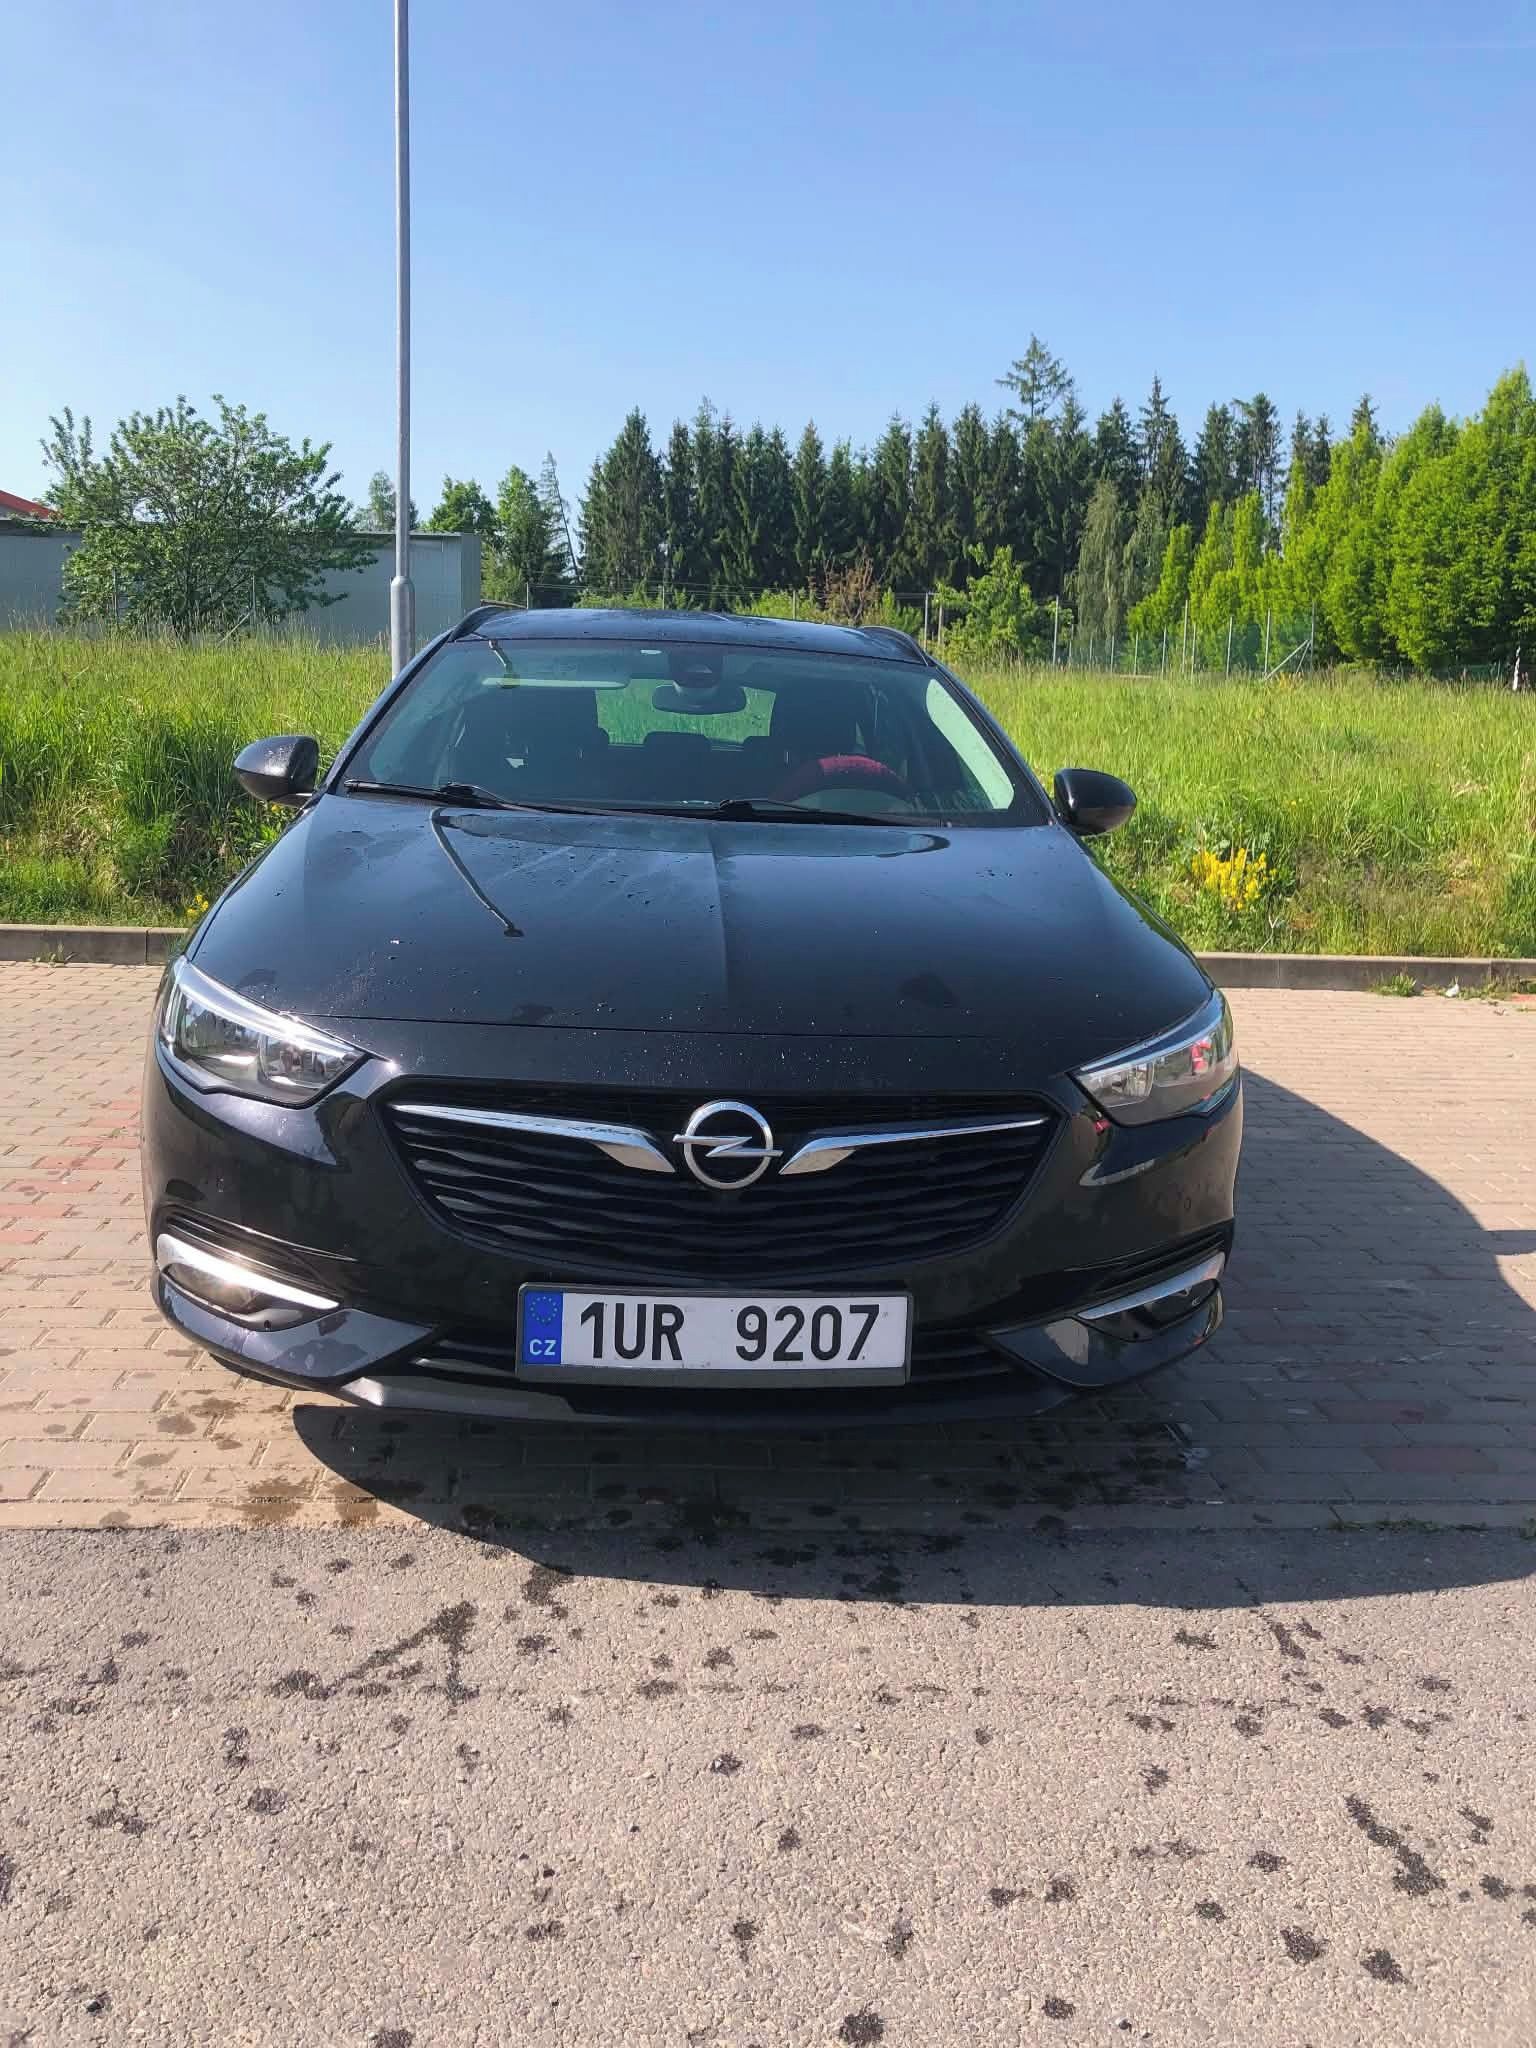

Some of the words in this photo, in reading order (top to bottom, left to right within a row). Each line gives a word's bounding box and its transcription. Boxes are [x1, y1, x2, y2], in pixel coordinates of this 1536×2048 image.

[528, 1337, 556, 1356] CZ
[580, 1301, 685, 1361] 1UR
[735, 1303, 880, 1362] 9207
